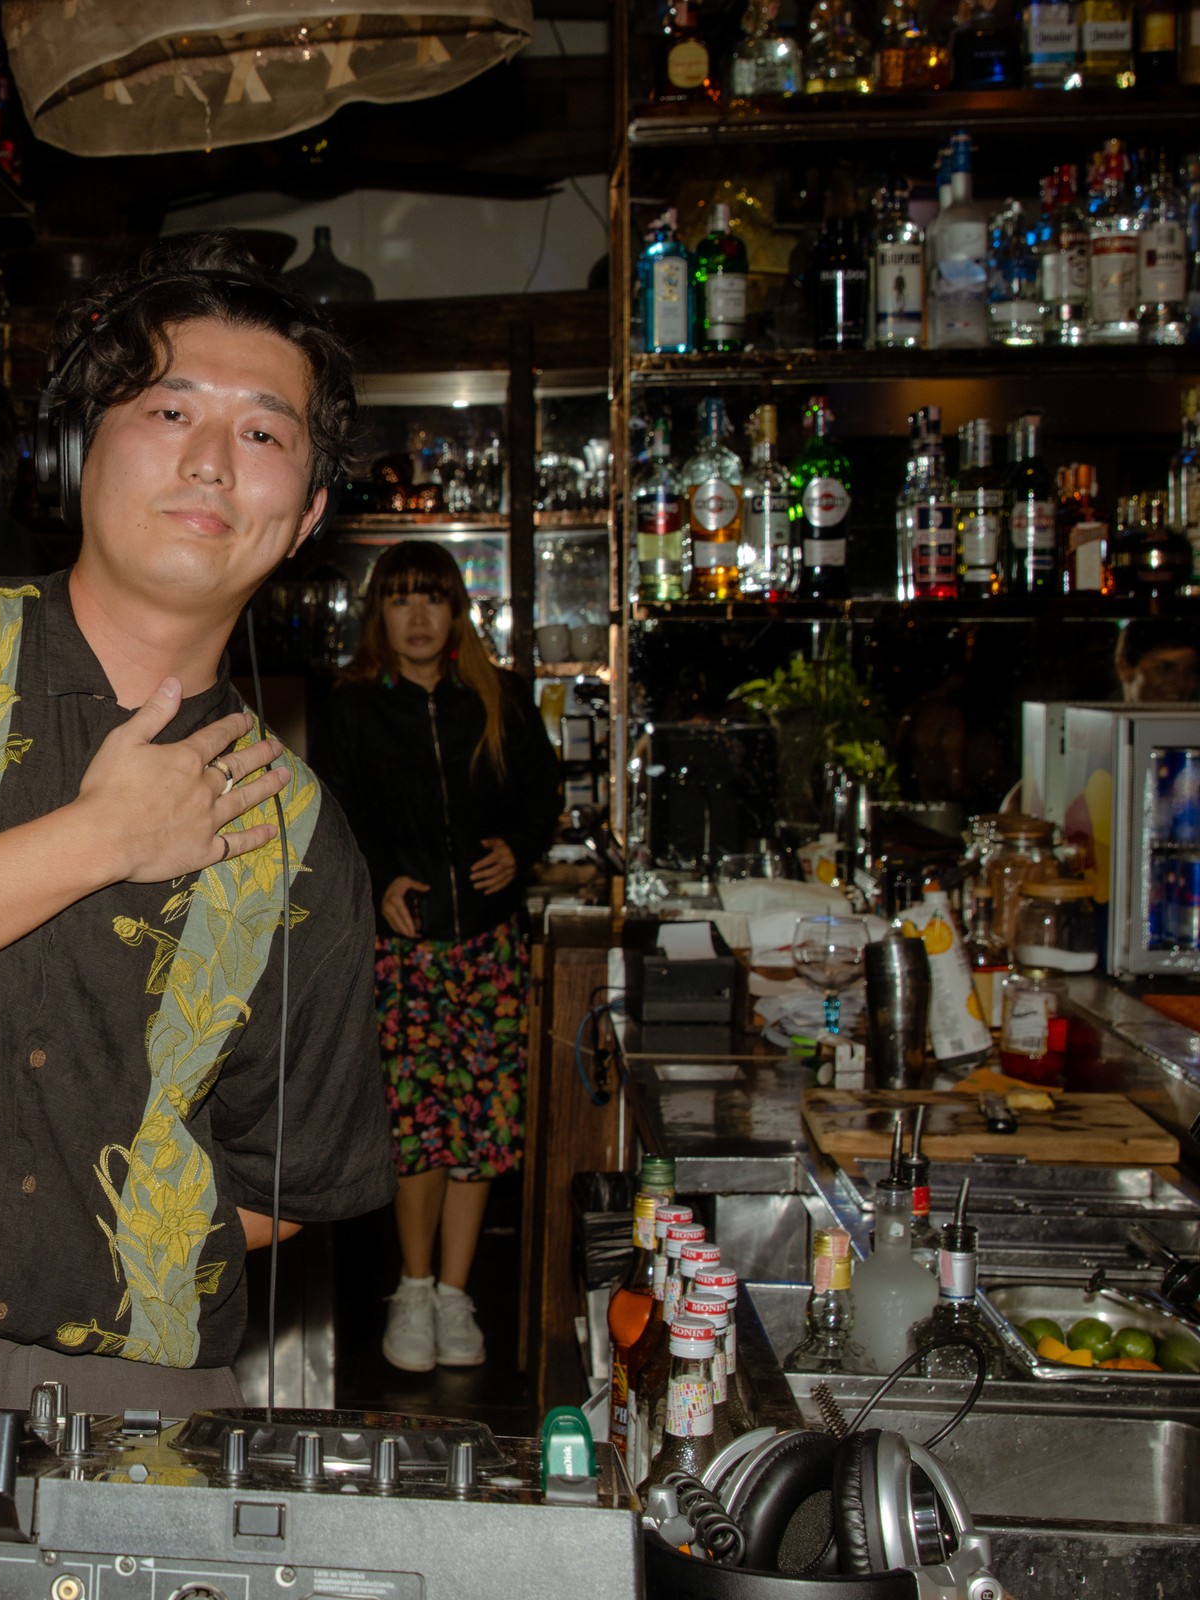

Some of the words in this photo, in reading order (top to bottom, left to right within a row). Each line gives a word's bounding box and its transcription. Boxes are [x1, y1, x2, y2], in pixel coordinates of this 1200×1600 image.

[671, 1231, 703, 1240] MONIN
[692, 1302, 727, 1312] MONIN
[671, 1326, 705, 1338] MONIN
